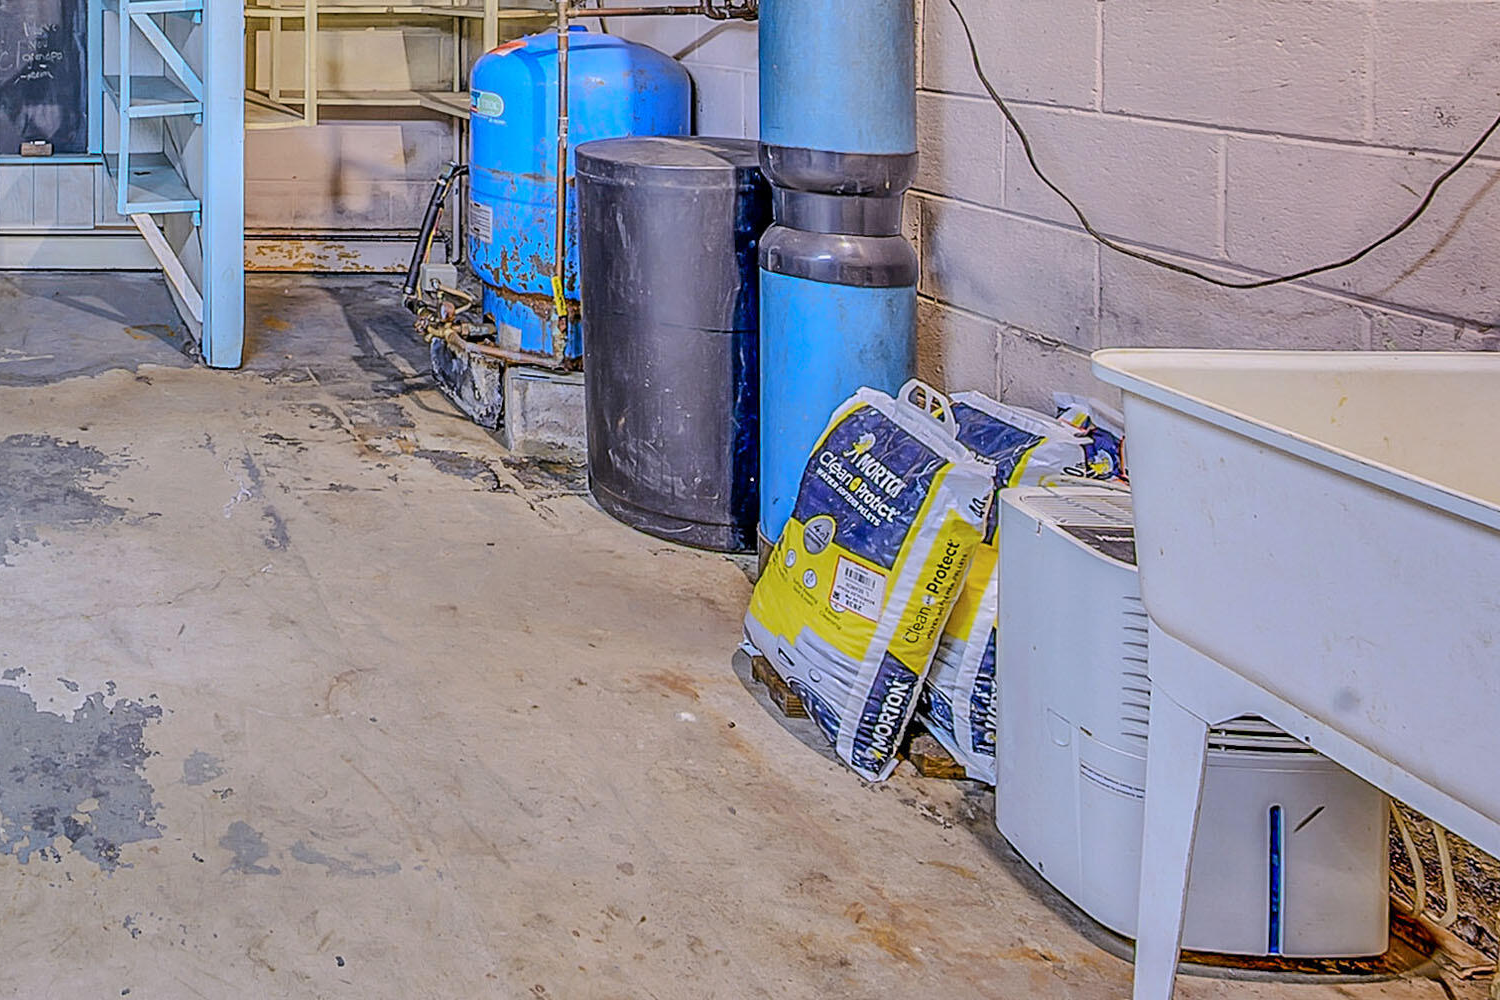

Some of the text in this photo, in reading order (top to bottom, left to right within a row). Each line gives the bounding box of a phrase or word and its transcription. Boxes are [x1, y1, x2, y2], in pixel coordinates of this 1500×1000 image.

[819, 451, 853, 487] Clean
[904, 539, 960, 644] Clean Protect
[872, 679, 912, 757] MORTON
